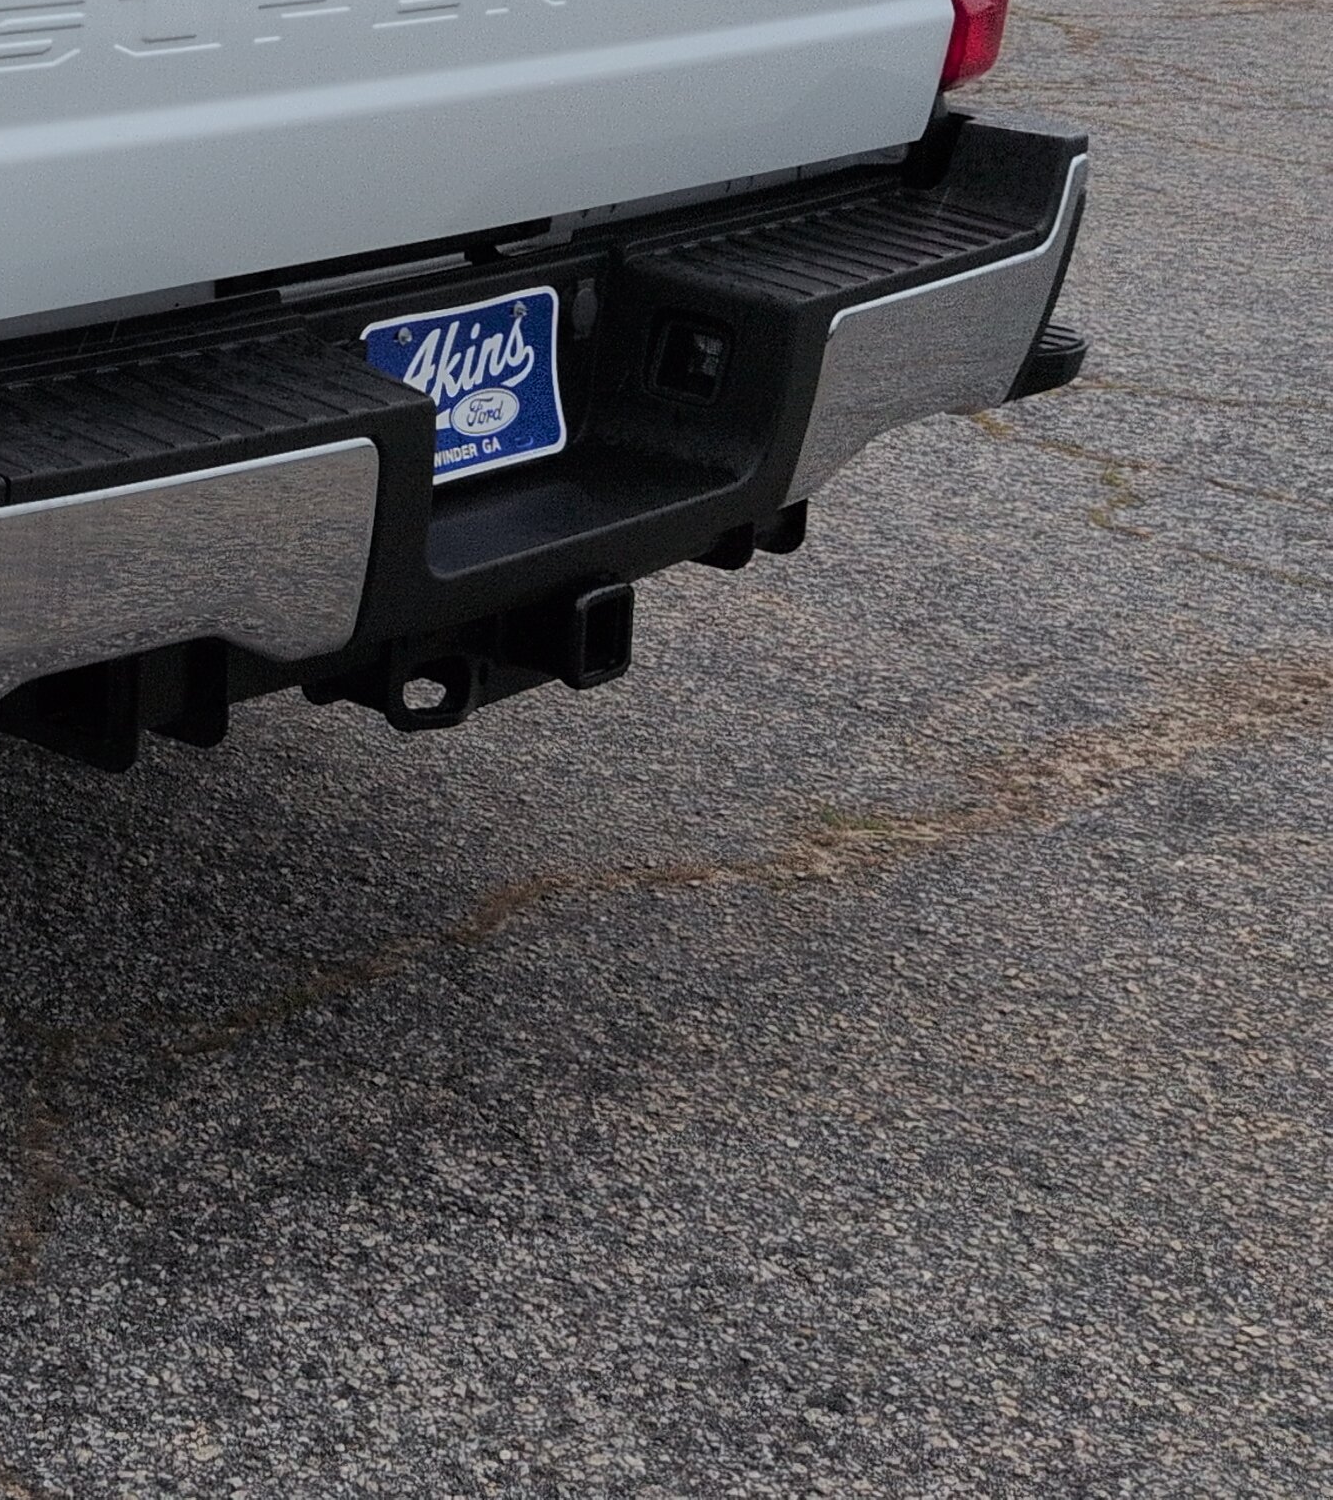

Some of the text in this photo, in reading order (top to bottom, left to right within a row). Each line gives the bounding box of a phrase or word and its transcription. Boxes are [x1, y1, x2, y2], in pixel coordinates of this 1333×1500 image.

[402, 316, 535, 407] Akins
[466, 396, 504, 427] Ford
[482, 436, 502, 454] GA
